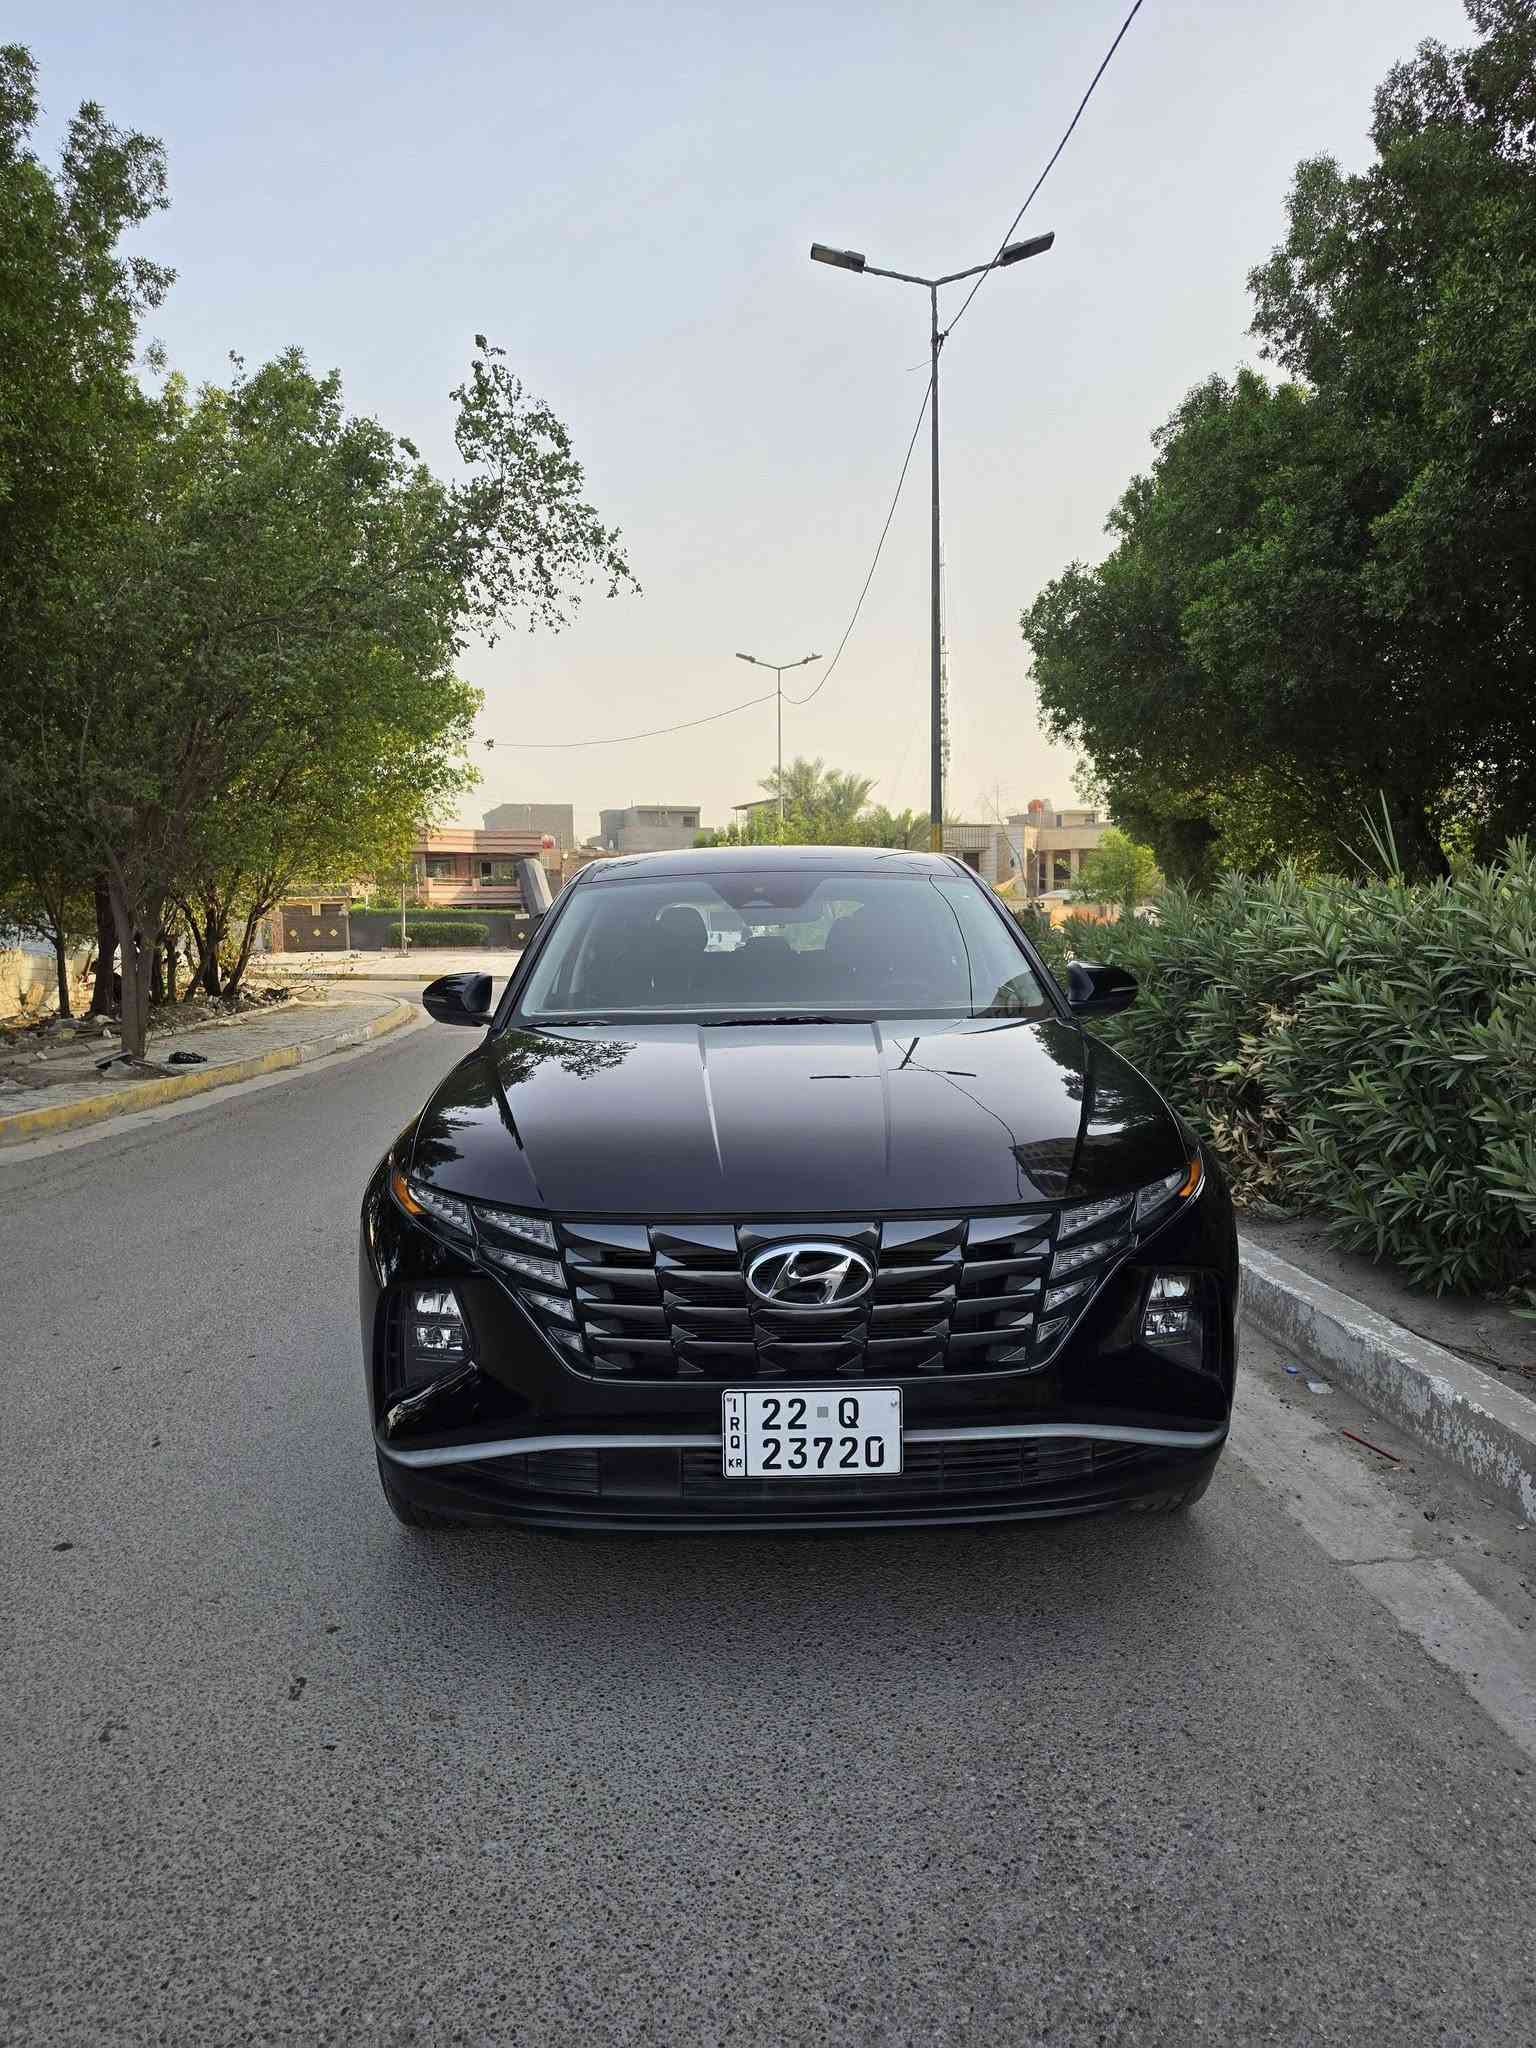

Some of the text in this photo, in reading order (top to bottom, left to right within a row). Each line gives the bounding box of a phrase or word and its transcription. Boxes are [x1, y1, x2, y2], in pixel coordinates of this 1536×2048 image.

[762, 1397, 859, 1430] 22 Q
[728, 1458, 743, 1469] KR
[762, 1436, 885, 1469] 23720
